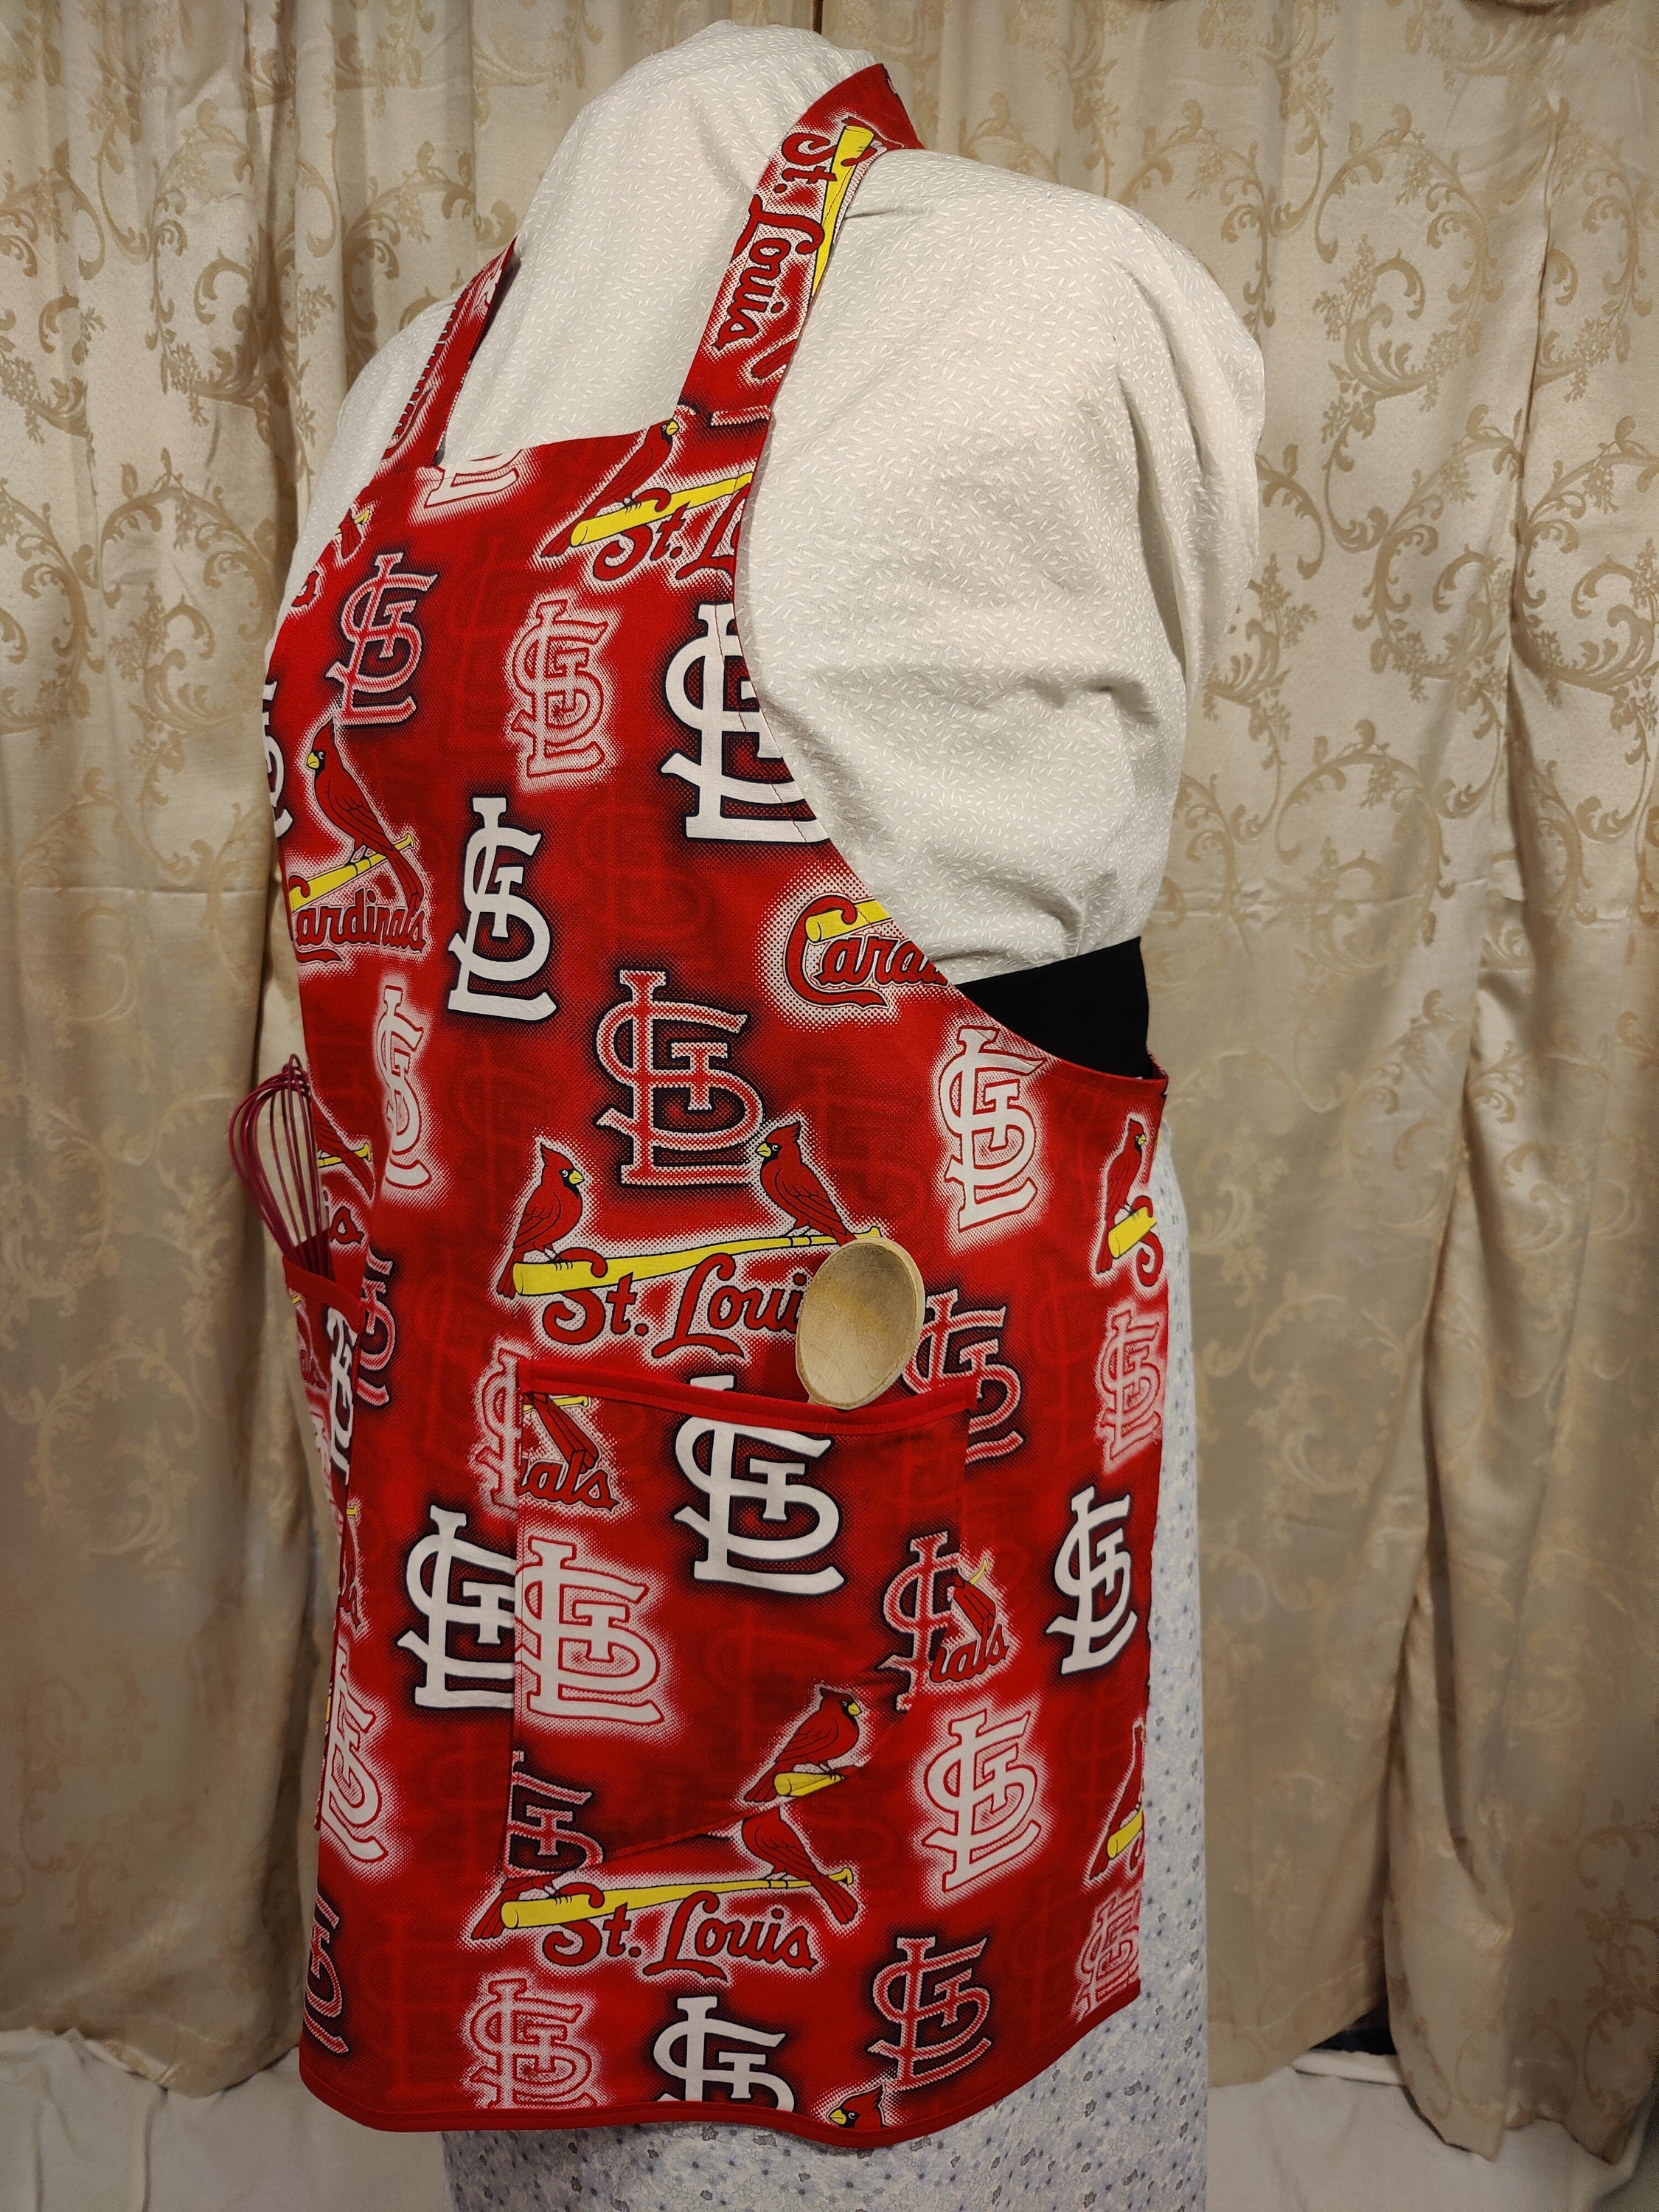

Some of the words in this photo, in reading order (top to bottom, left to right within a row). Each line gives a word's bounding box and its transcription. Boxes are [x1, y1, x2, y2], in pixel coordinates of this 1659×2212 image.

[774, 132, 876, 193] St.
[712, 194, 825, 350] Louis
[592, 487, 686, 581] St.
[542, 1248, 650, 1345] St.
[653, 1253, 804, 1359] Loui
[542, 1882, 642, 1966] St.
[641, 1891, 818, 1982] Louis
